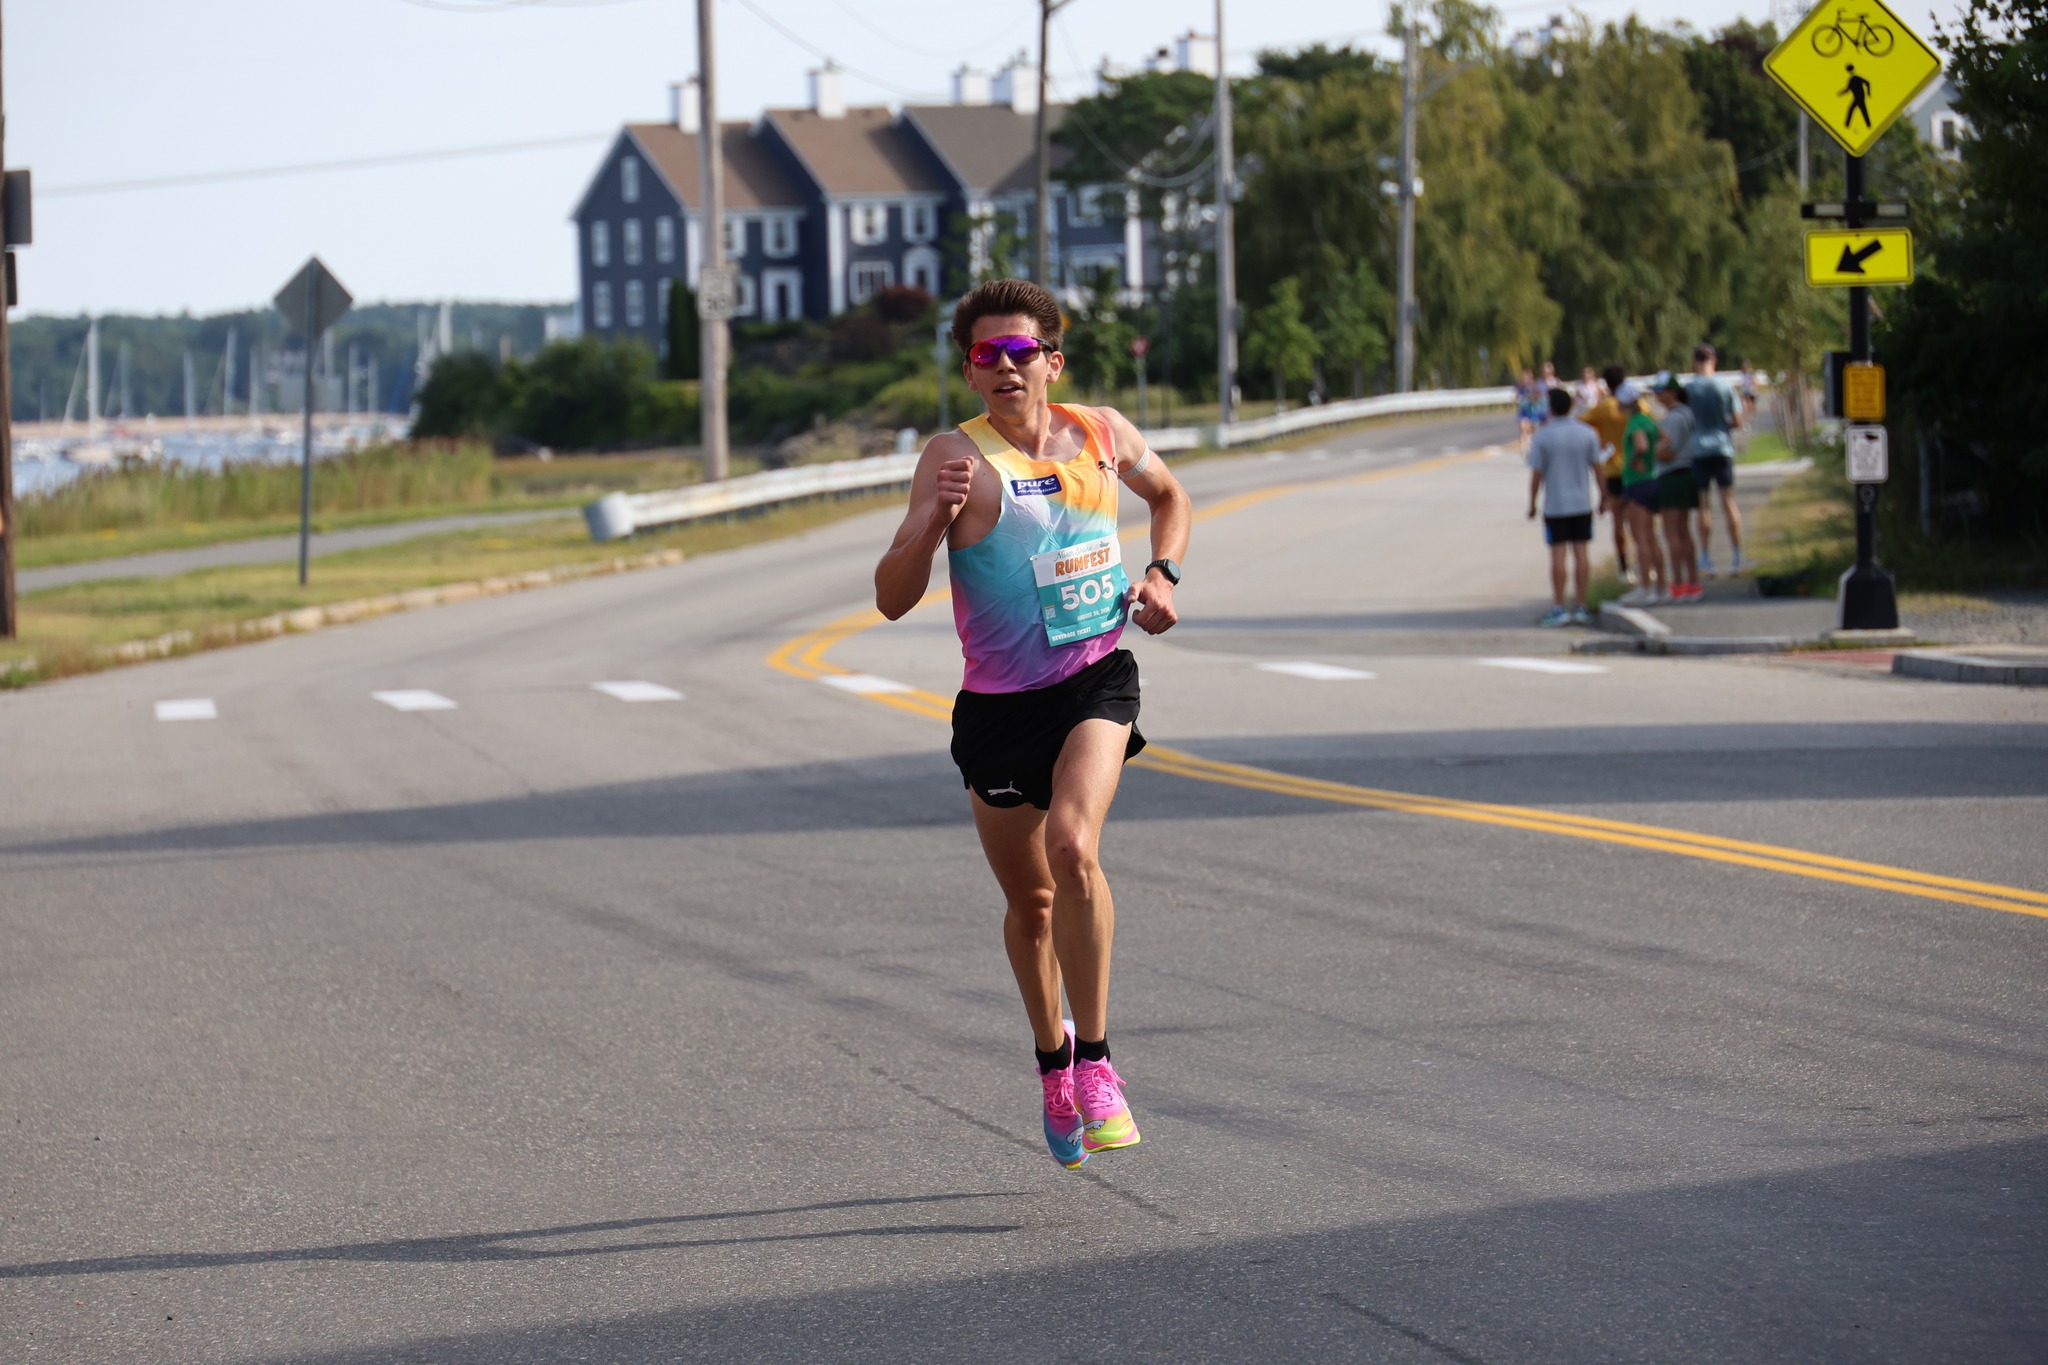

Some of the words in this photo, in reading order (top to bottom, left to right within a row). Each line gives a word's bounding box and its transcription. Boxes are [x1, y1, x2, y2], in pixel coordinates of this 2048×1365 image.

[1017, 477, 1055, 490] pure
[1055, 547, 1110, 577] RUNFEST
[1061, 573, 1114, 611] 505
